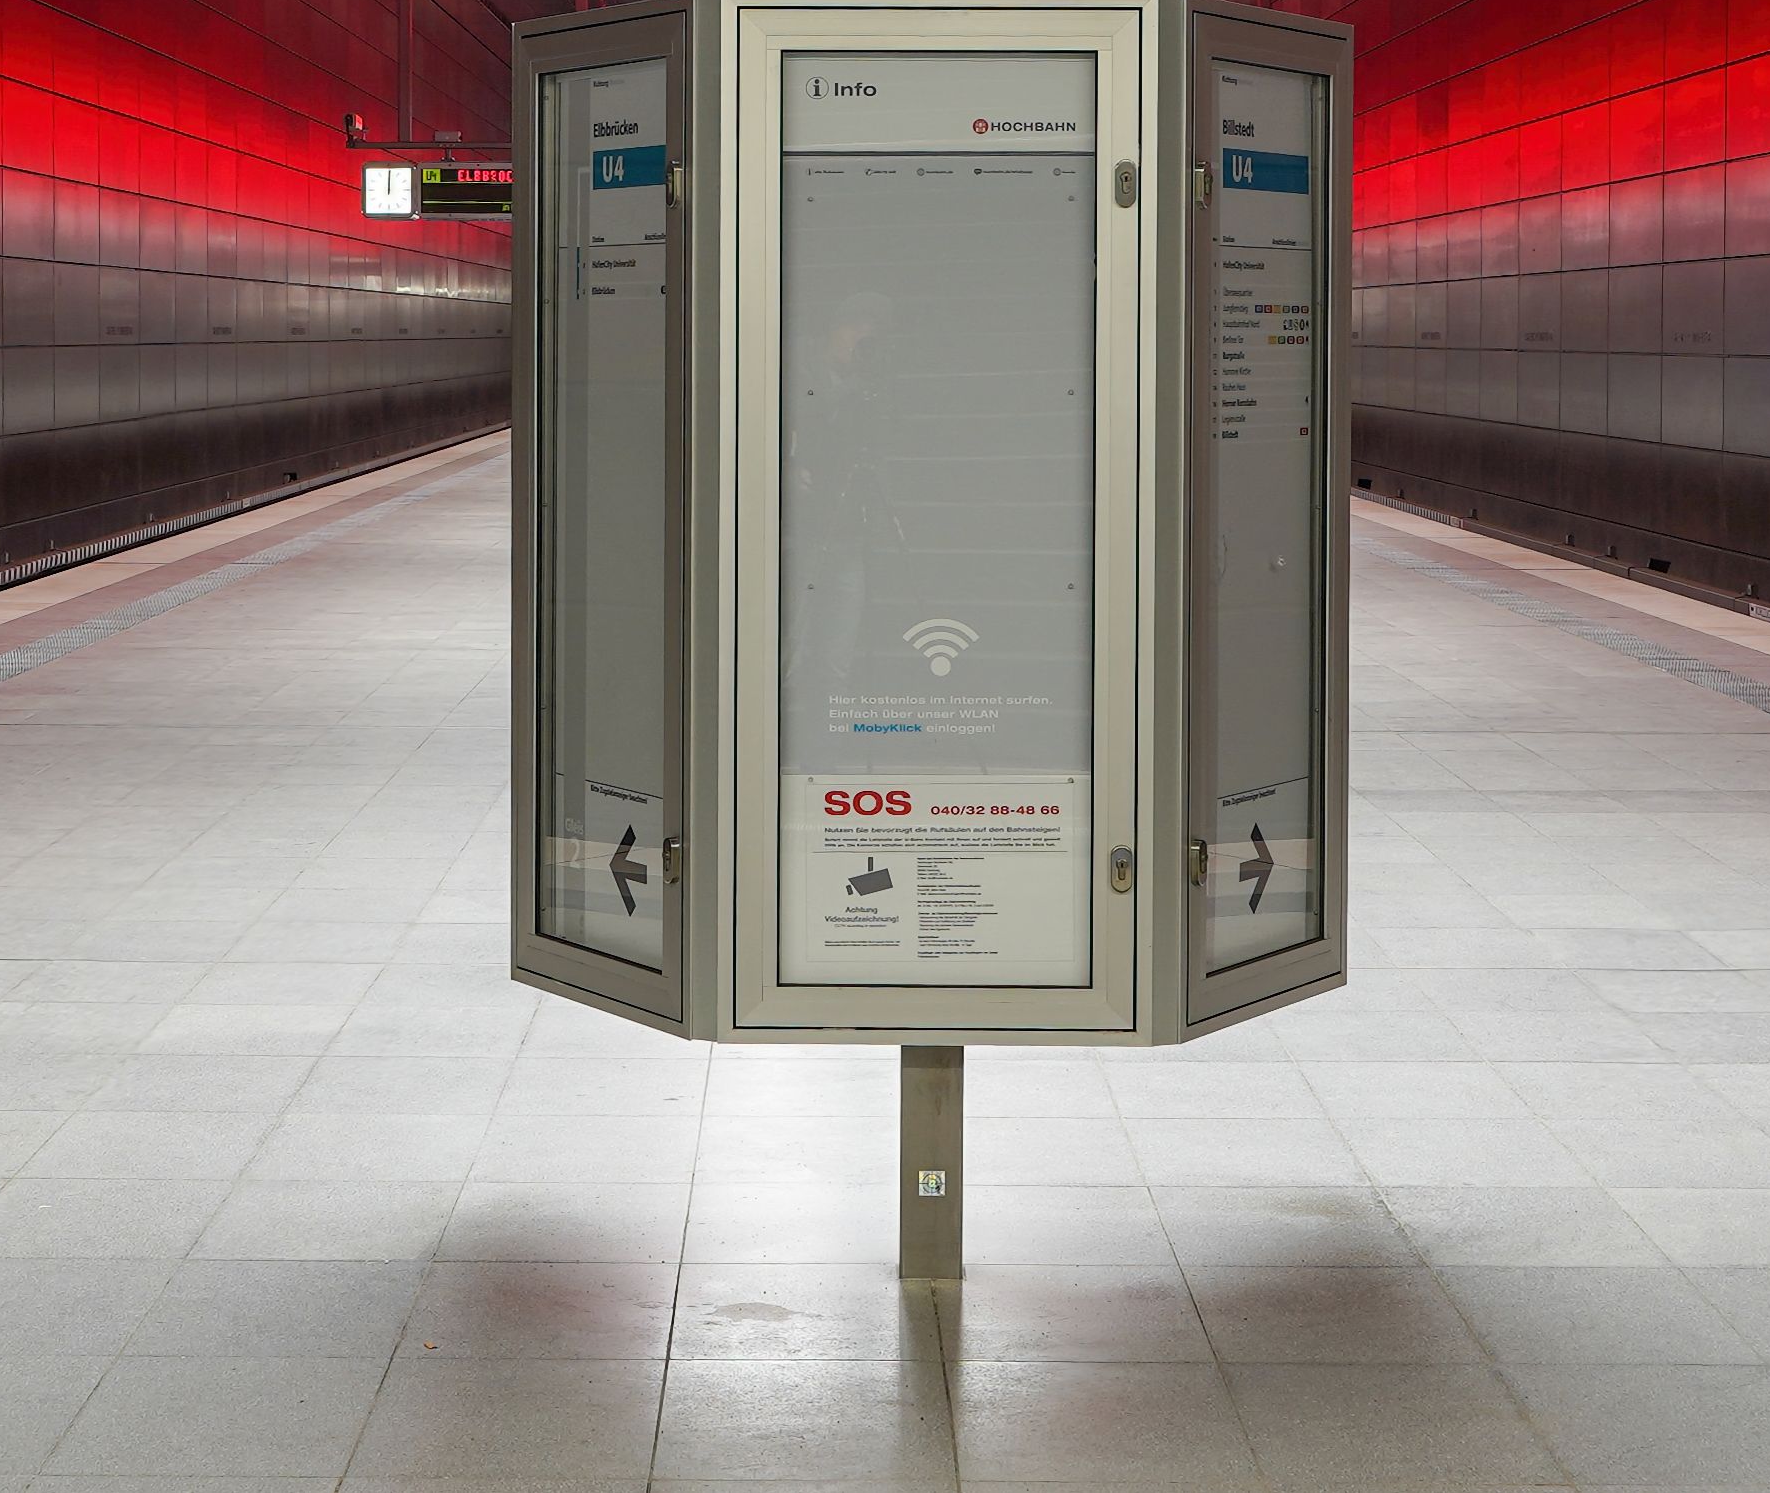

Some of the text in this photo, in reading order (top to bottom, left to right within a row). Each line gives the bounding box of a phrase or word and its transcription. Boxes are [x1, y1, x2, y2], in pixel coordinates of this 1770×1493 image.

[834, 82, 877, 97] Info
[593, 119, 639, 138] Elbbrücken
[990, 121, 1076, 132] HOCHBAHN
[1222, 119, 1255, 138] Billstedt
[602, 155, 625, 183] U4
[1232, 154, 1253, 184] U4
[829, 695, 857, 705] Hier
[860, 695, 927, 705] kostenlos
[1006, 695, 1053, 705] surfen.
[829, 708, 999, 719] Einfach über unser WLAN
[829, 723, 996, 735] bei MobyKlick einloggen!
[824, 790, 912, 816] SOS
[930, 805, 1060, 816] 040/32 88-48 66
